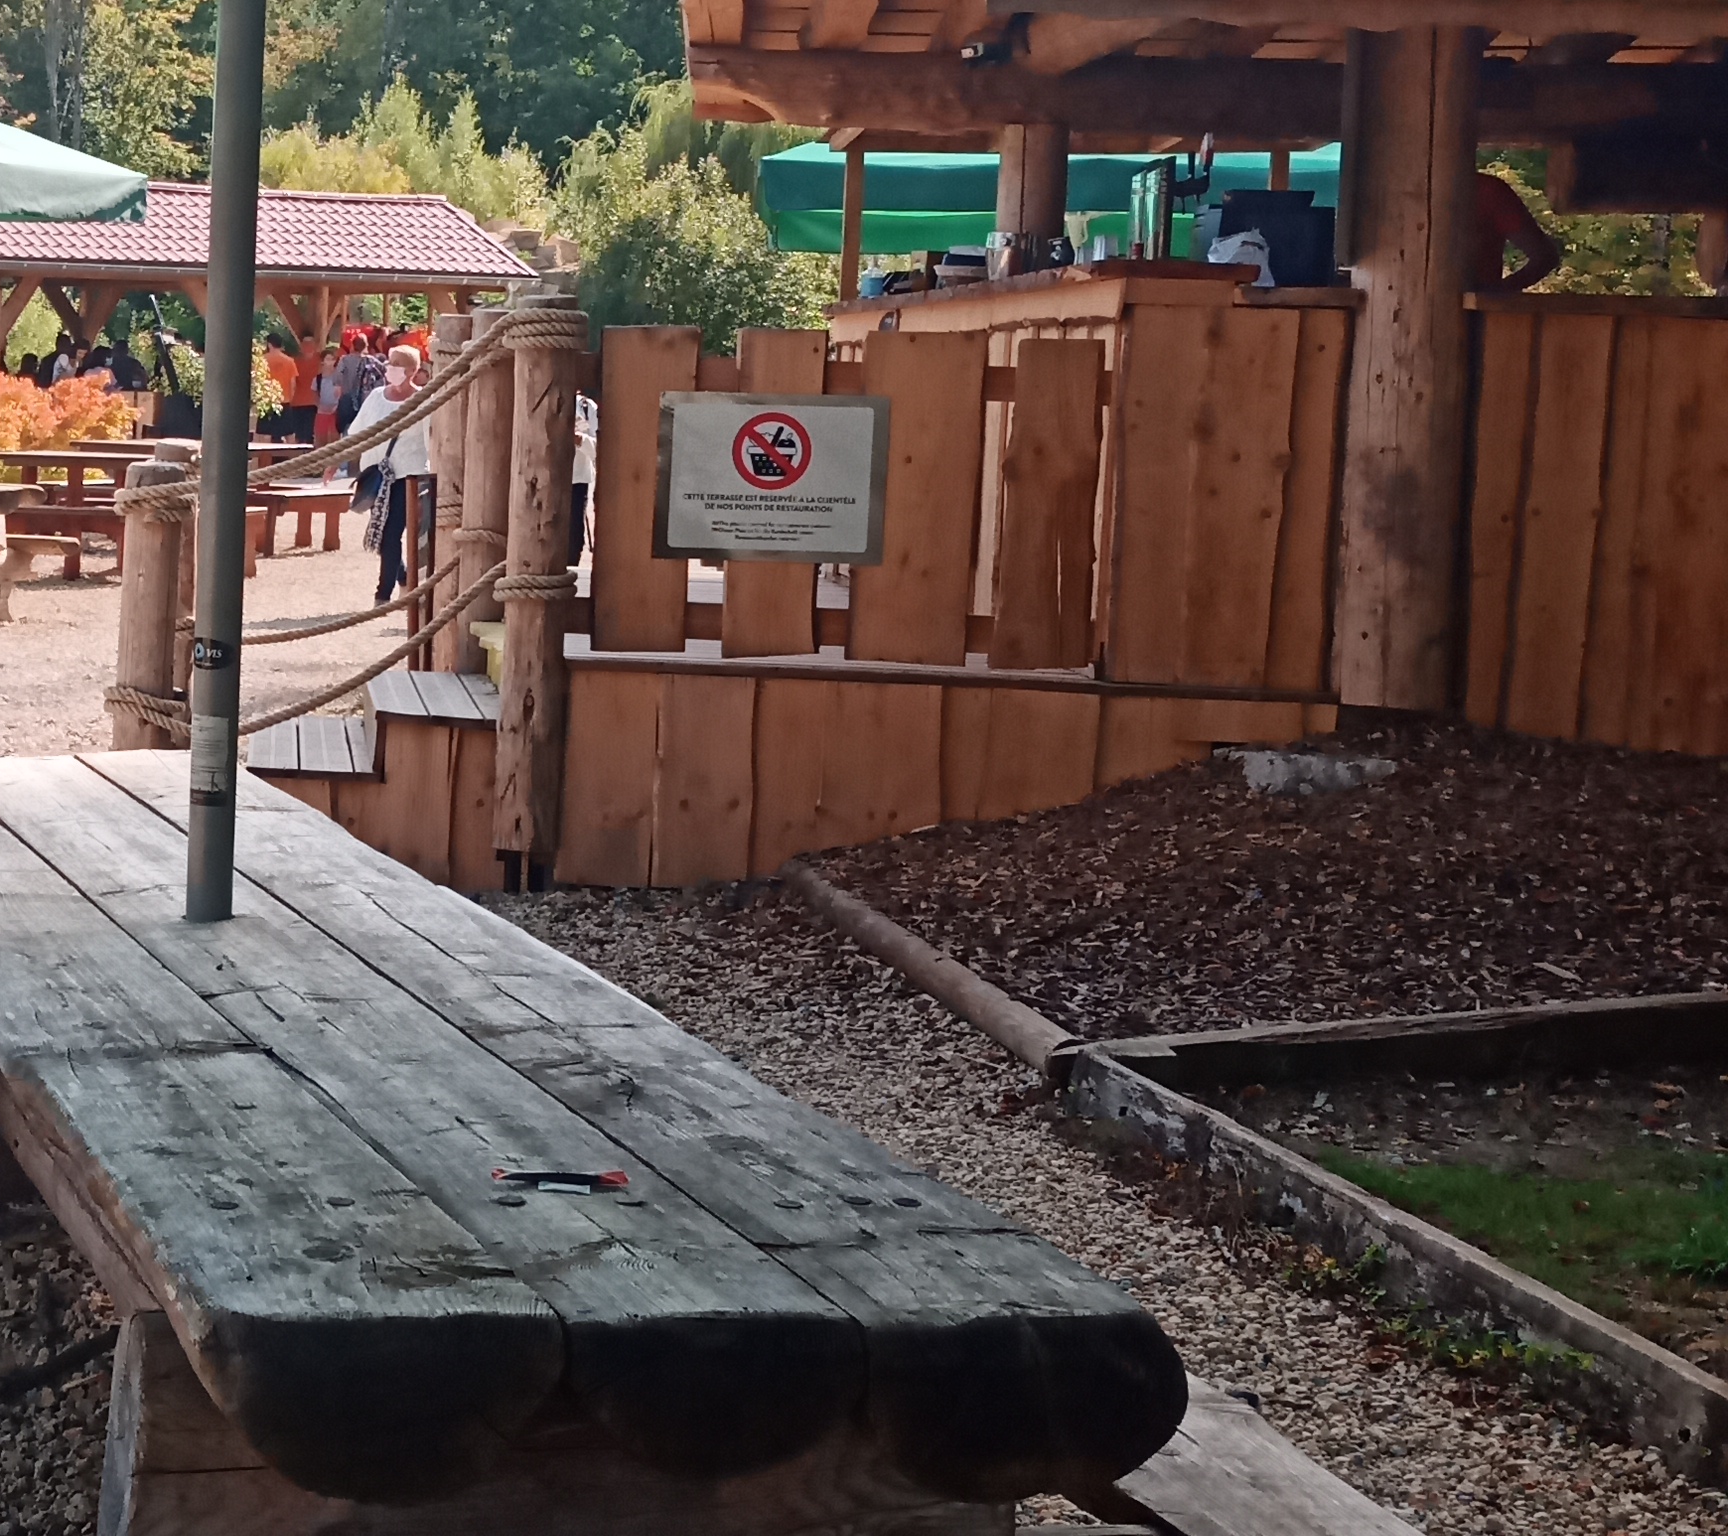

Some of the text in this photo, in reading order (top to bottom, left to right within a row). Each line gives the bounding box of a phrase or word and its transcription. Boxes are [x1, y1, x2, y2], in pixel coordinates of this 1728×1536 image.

[704, 502, 833, 513] DE NOS POINTS DE RESTAURATION
